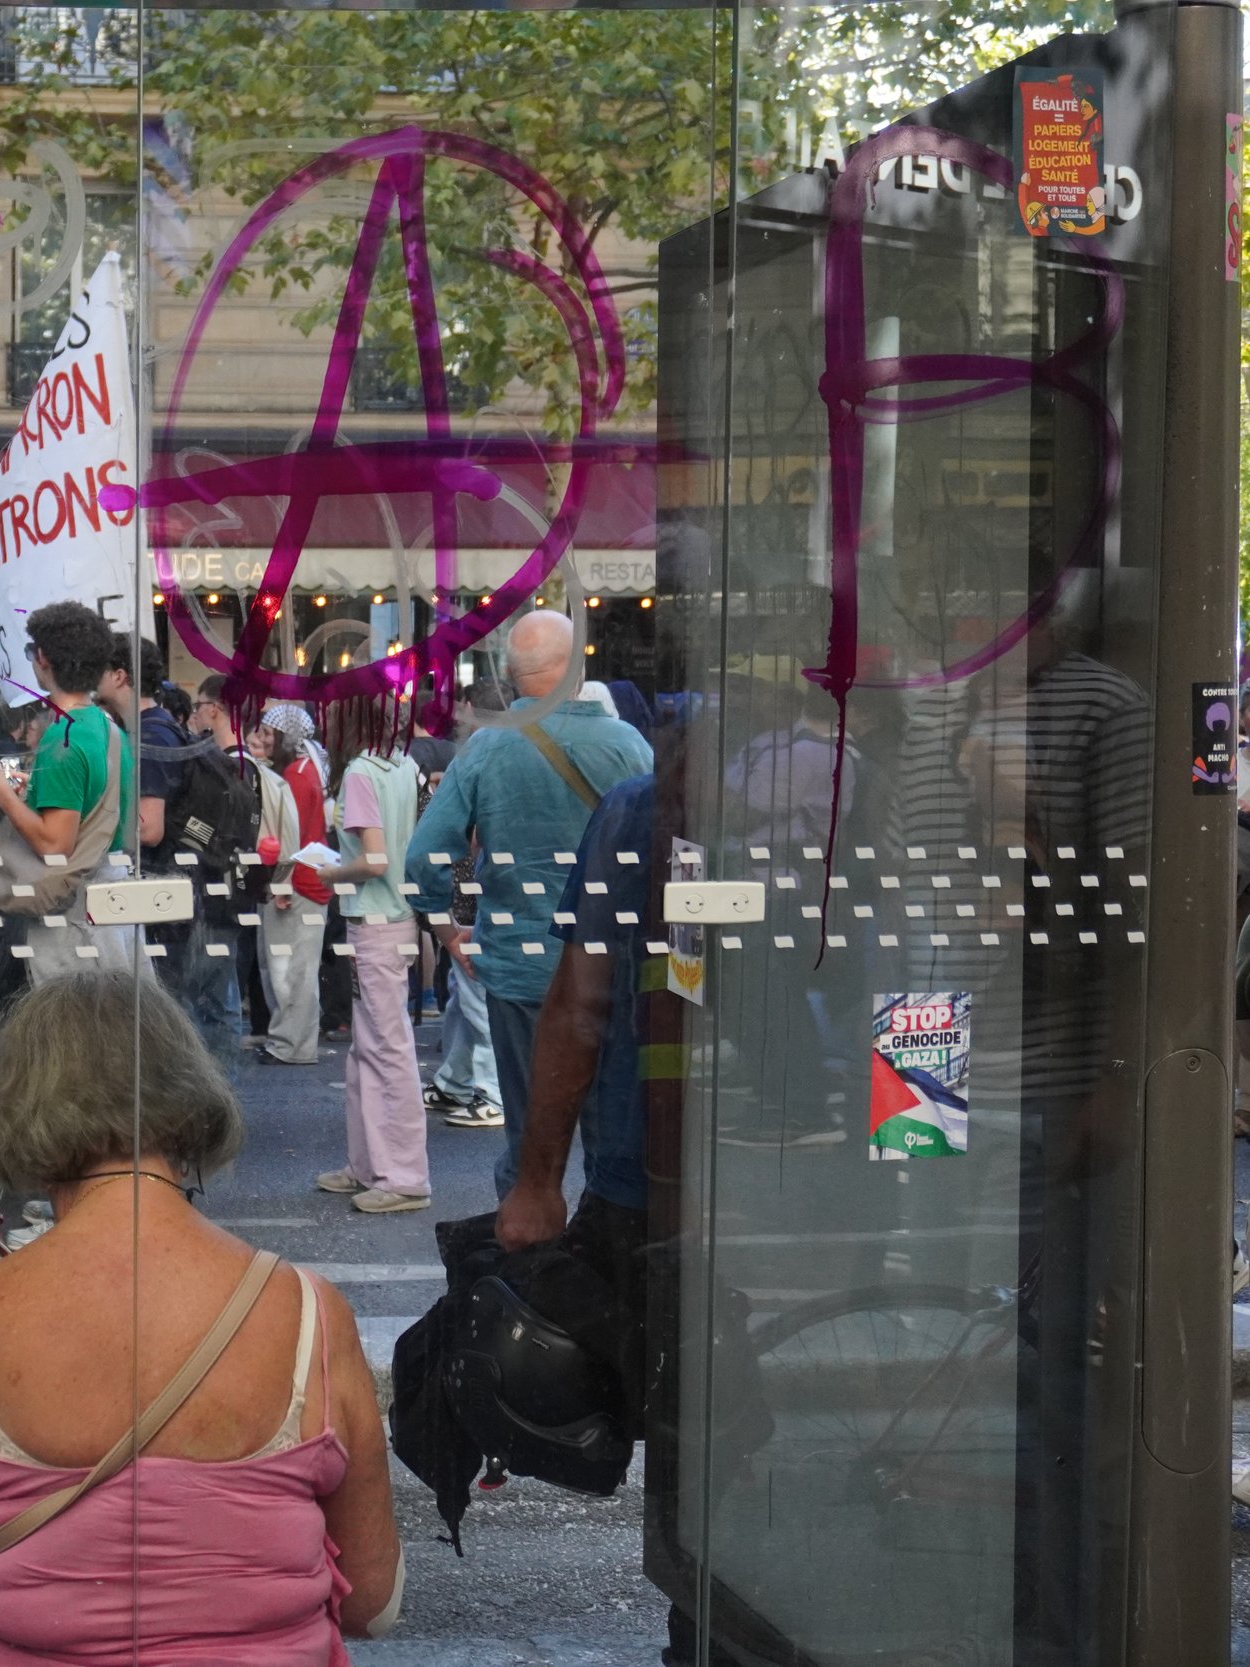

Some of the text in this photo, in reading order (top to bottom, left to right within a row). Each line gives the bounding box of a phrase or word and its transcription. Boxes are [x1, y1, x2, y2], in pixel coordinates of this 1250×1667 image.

[1032, 96, 1079, 112] ÉGALITÉ
[1034, 125, 1082, 136] PAPIERS
[1028, 140, 1090, 152] LOGEMENT
[1028, 154, 1092, 169] ÉDUCATION
[1041, 169, 1079, 183] SANTÉ
[1038, 185, 1086, 194] POUR TOUTES
[1058, 194, 1077, 202] TOUS
[1202, 688, 1227, 697] CONTRE
[892, 1005, 950, 1032] STOP
